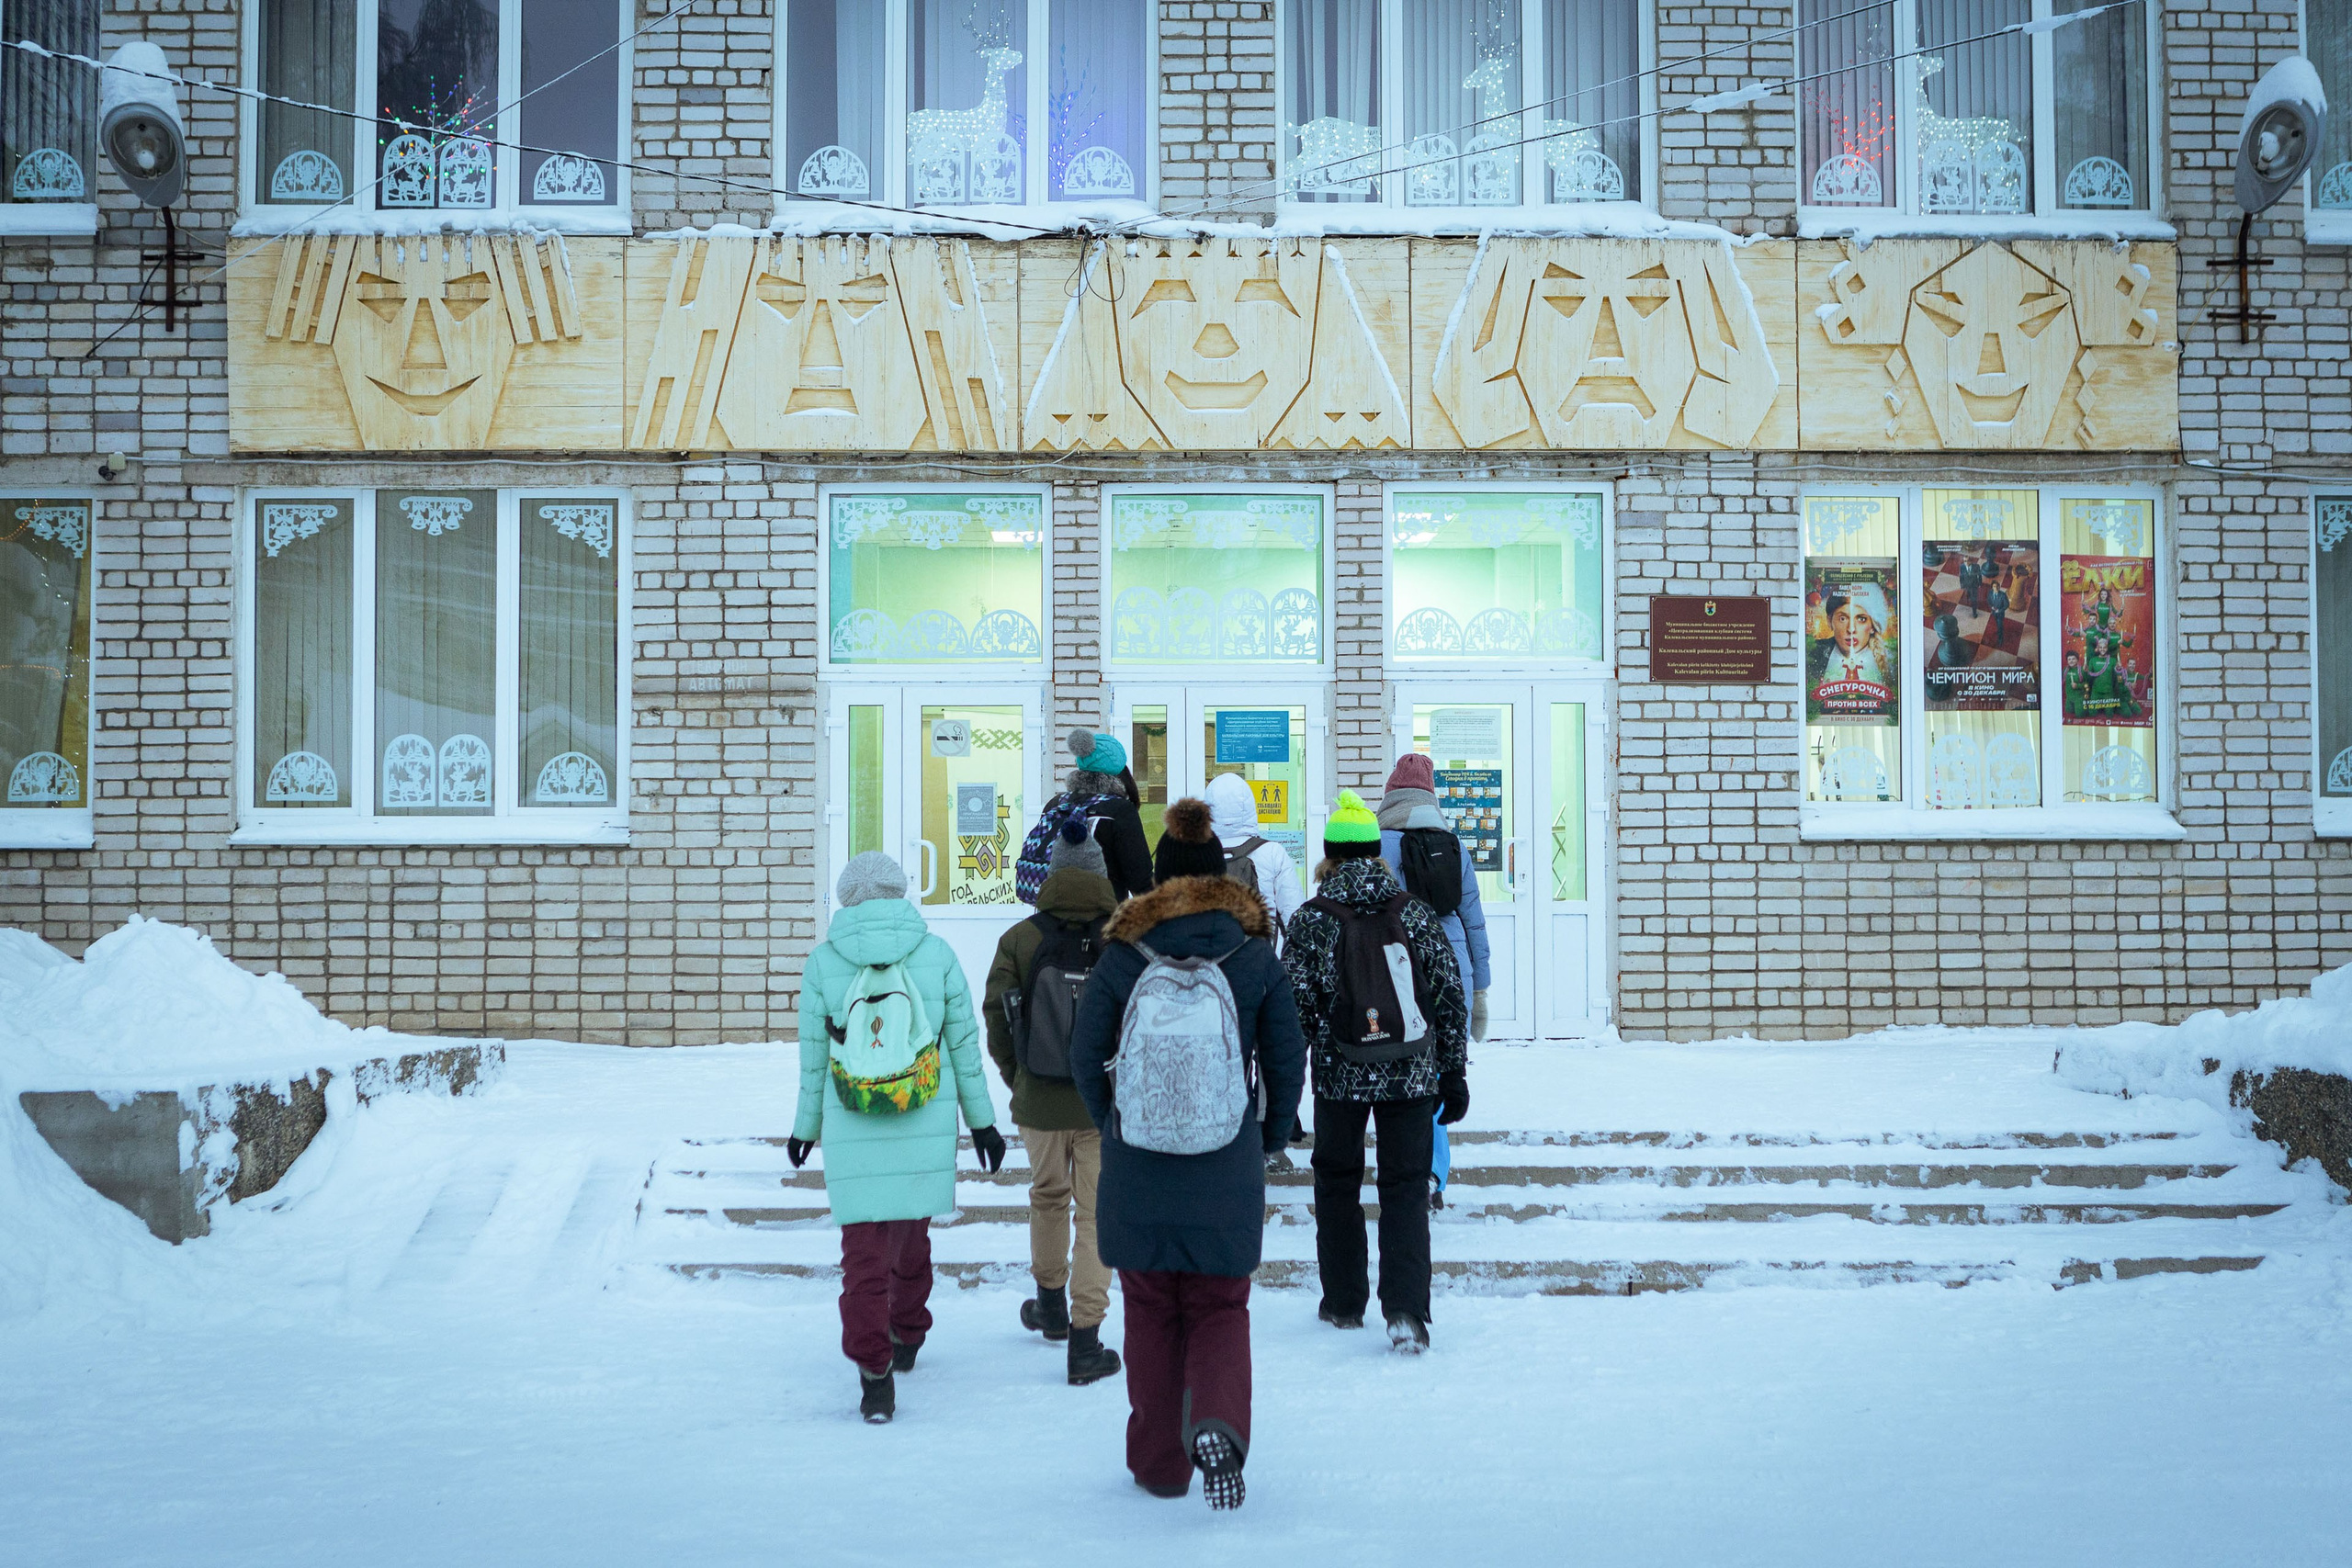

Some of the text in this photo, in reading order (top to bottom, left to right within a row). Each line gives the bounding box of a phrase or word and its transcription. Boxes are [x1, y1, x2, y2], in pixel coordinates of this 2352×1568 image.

[2062, 558, 2144, 592] ЁЛКИ
[1928, 671, 2034, 683] ЧЕМПИОН МИРА
[1819, 683, 1885, 698] СНЕГУРОЧКА
[951, 883, 973, 902] ГОД
[967, 880, 1012, 904] ЕЛЬСКИХ
